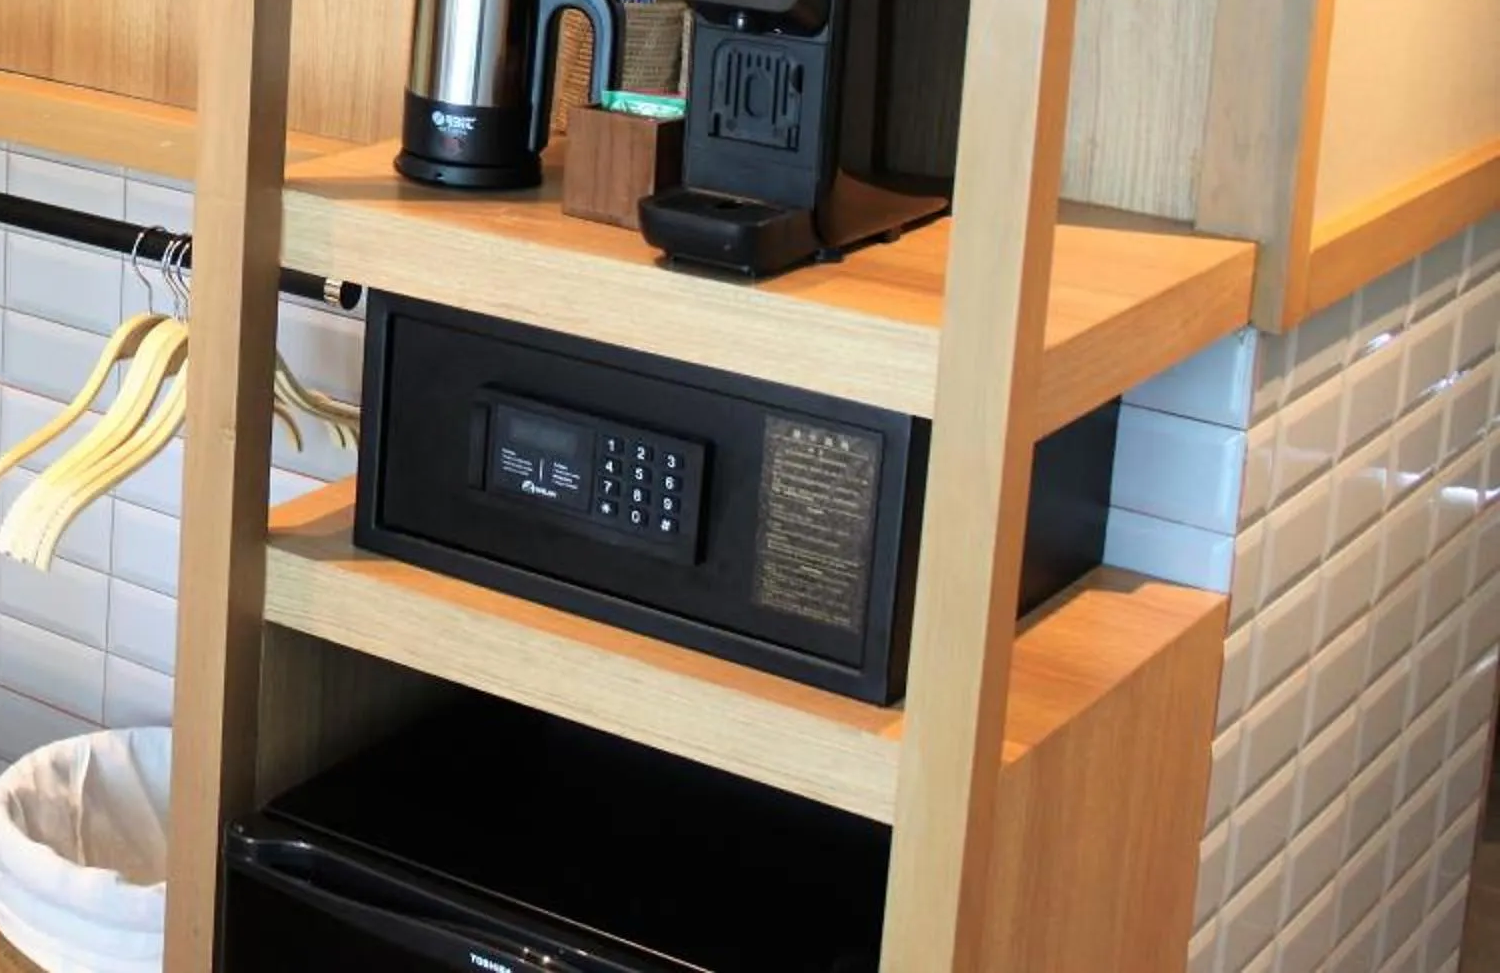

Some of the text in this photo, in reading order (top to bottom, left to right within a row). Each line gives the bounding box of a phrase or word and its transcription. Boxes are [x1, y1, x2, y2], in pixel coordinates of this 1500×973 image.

[607, 439, 676, 468] 1 2 3
[605, 460, 674, 490] 4 5 6
[603, 480, 673, 511] 7 8 9
[631, 510, 641, 524] 0
